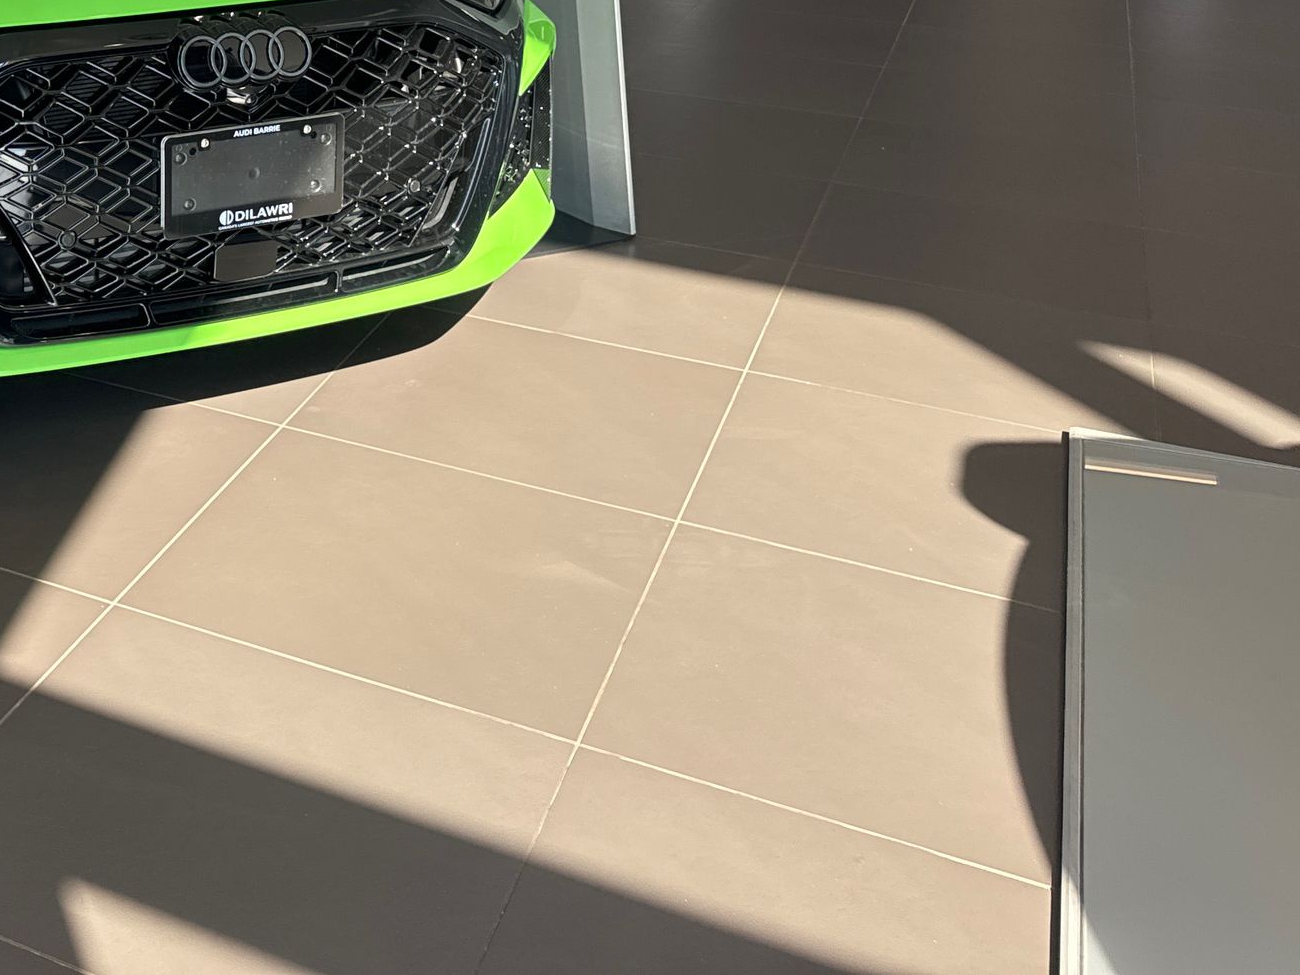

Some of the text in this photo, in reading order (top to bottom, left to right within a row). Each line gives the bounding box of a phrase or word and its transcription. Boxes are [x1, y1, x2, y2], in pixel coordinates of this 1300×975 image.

[233, 124, 281, 138] AUDI BARRIE
[234, 202, 293, 222] DILAWRI
